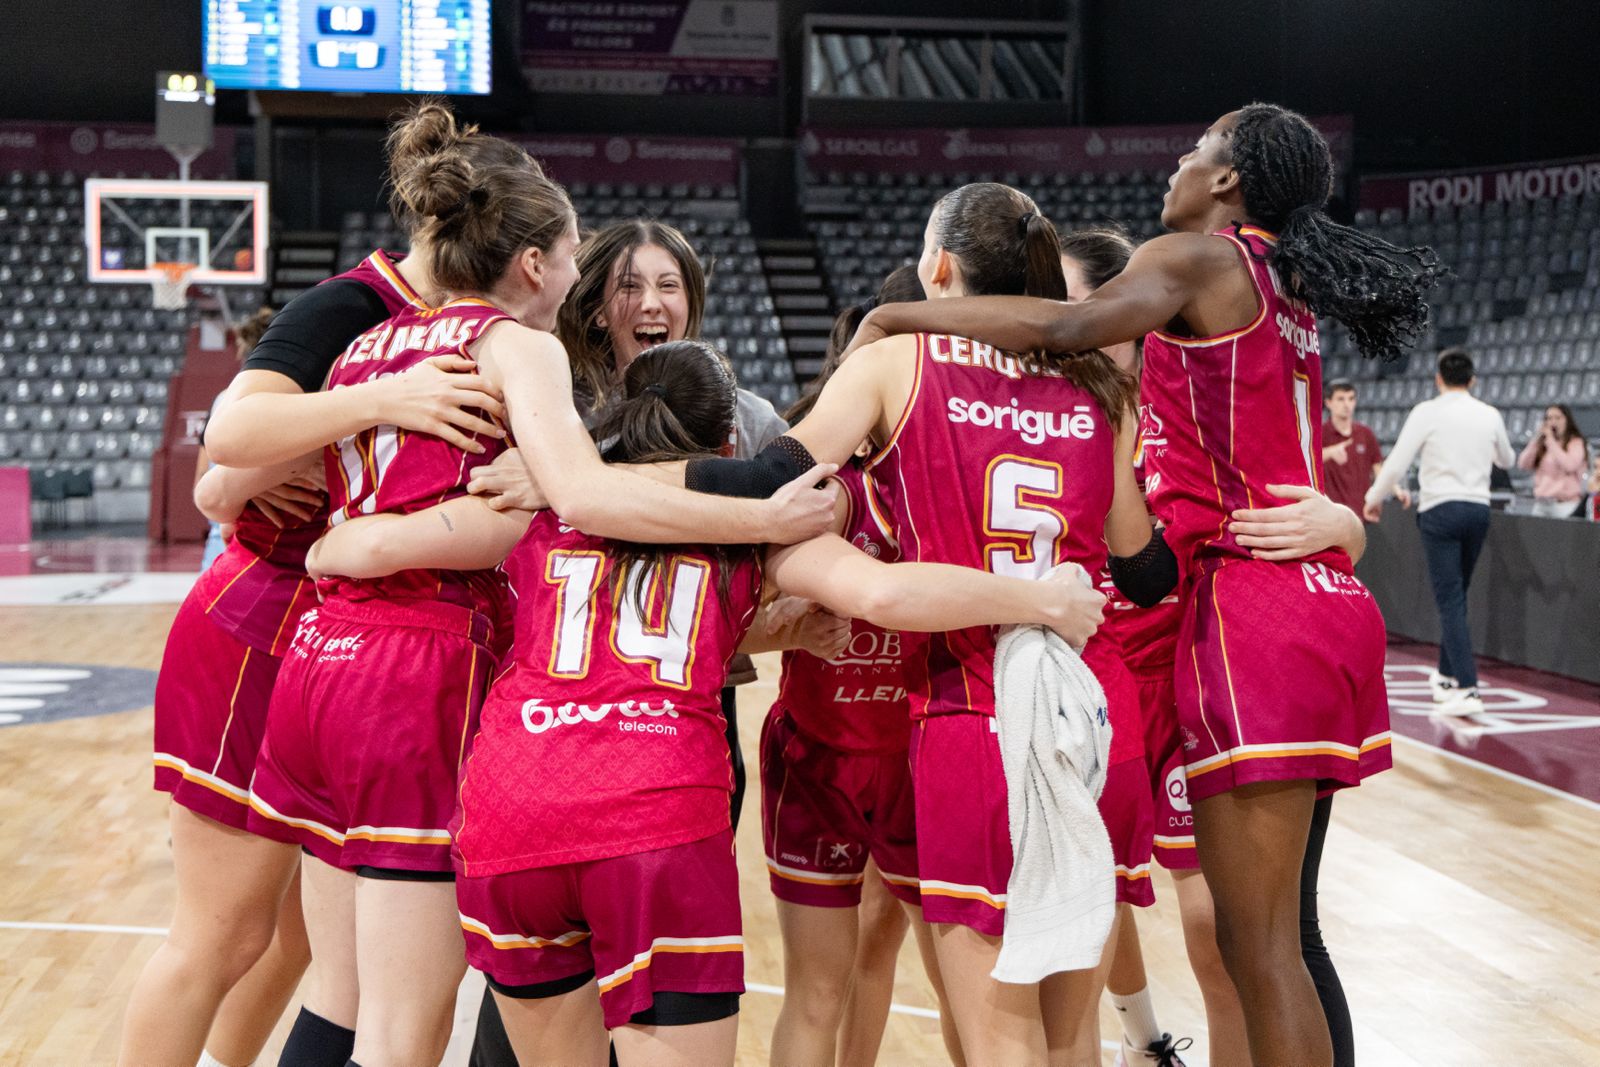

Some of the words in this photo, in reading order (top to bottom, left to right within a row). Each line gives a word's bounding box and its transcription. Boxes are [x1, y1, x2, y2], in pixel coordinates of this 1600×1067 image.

[1408, 175, 1483, 207] RODI
[1496, 162, 1600, 202] MOTOR
[983, 453, 1068, 581] 5
[545, 549, 711, 691] 14
[618, 719, 678, 736] telecom
